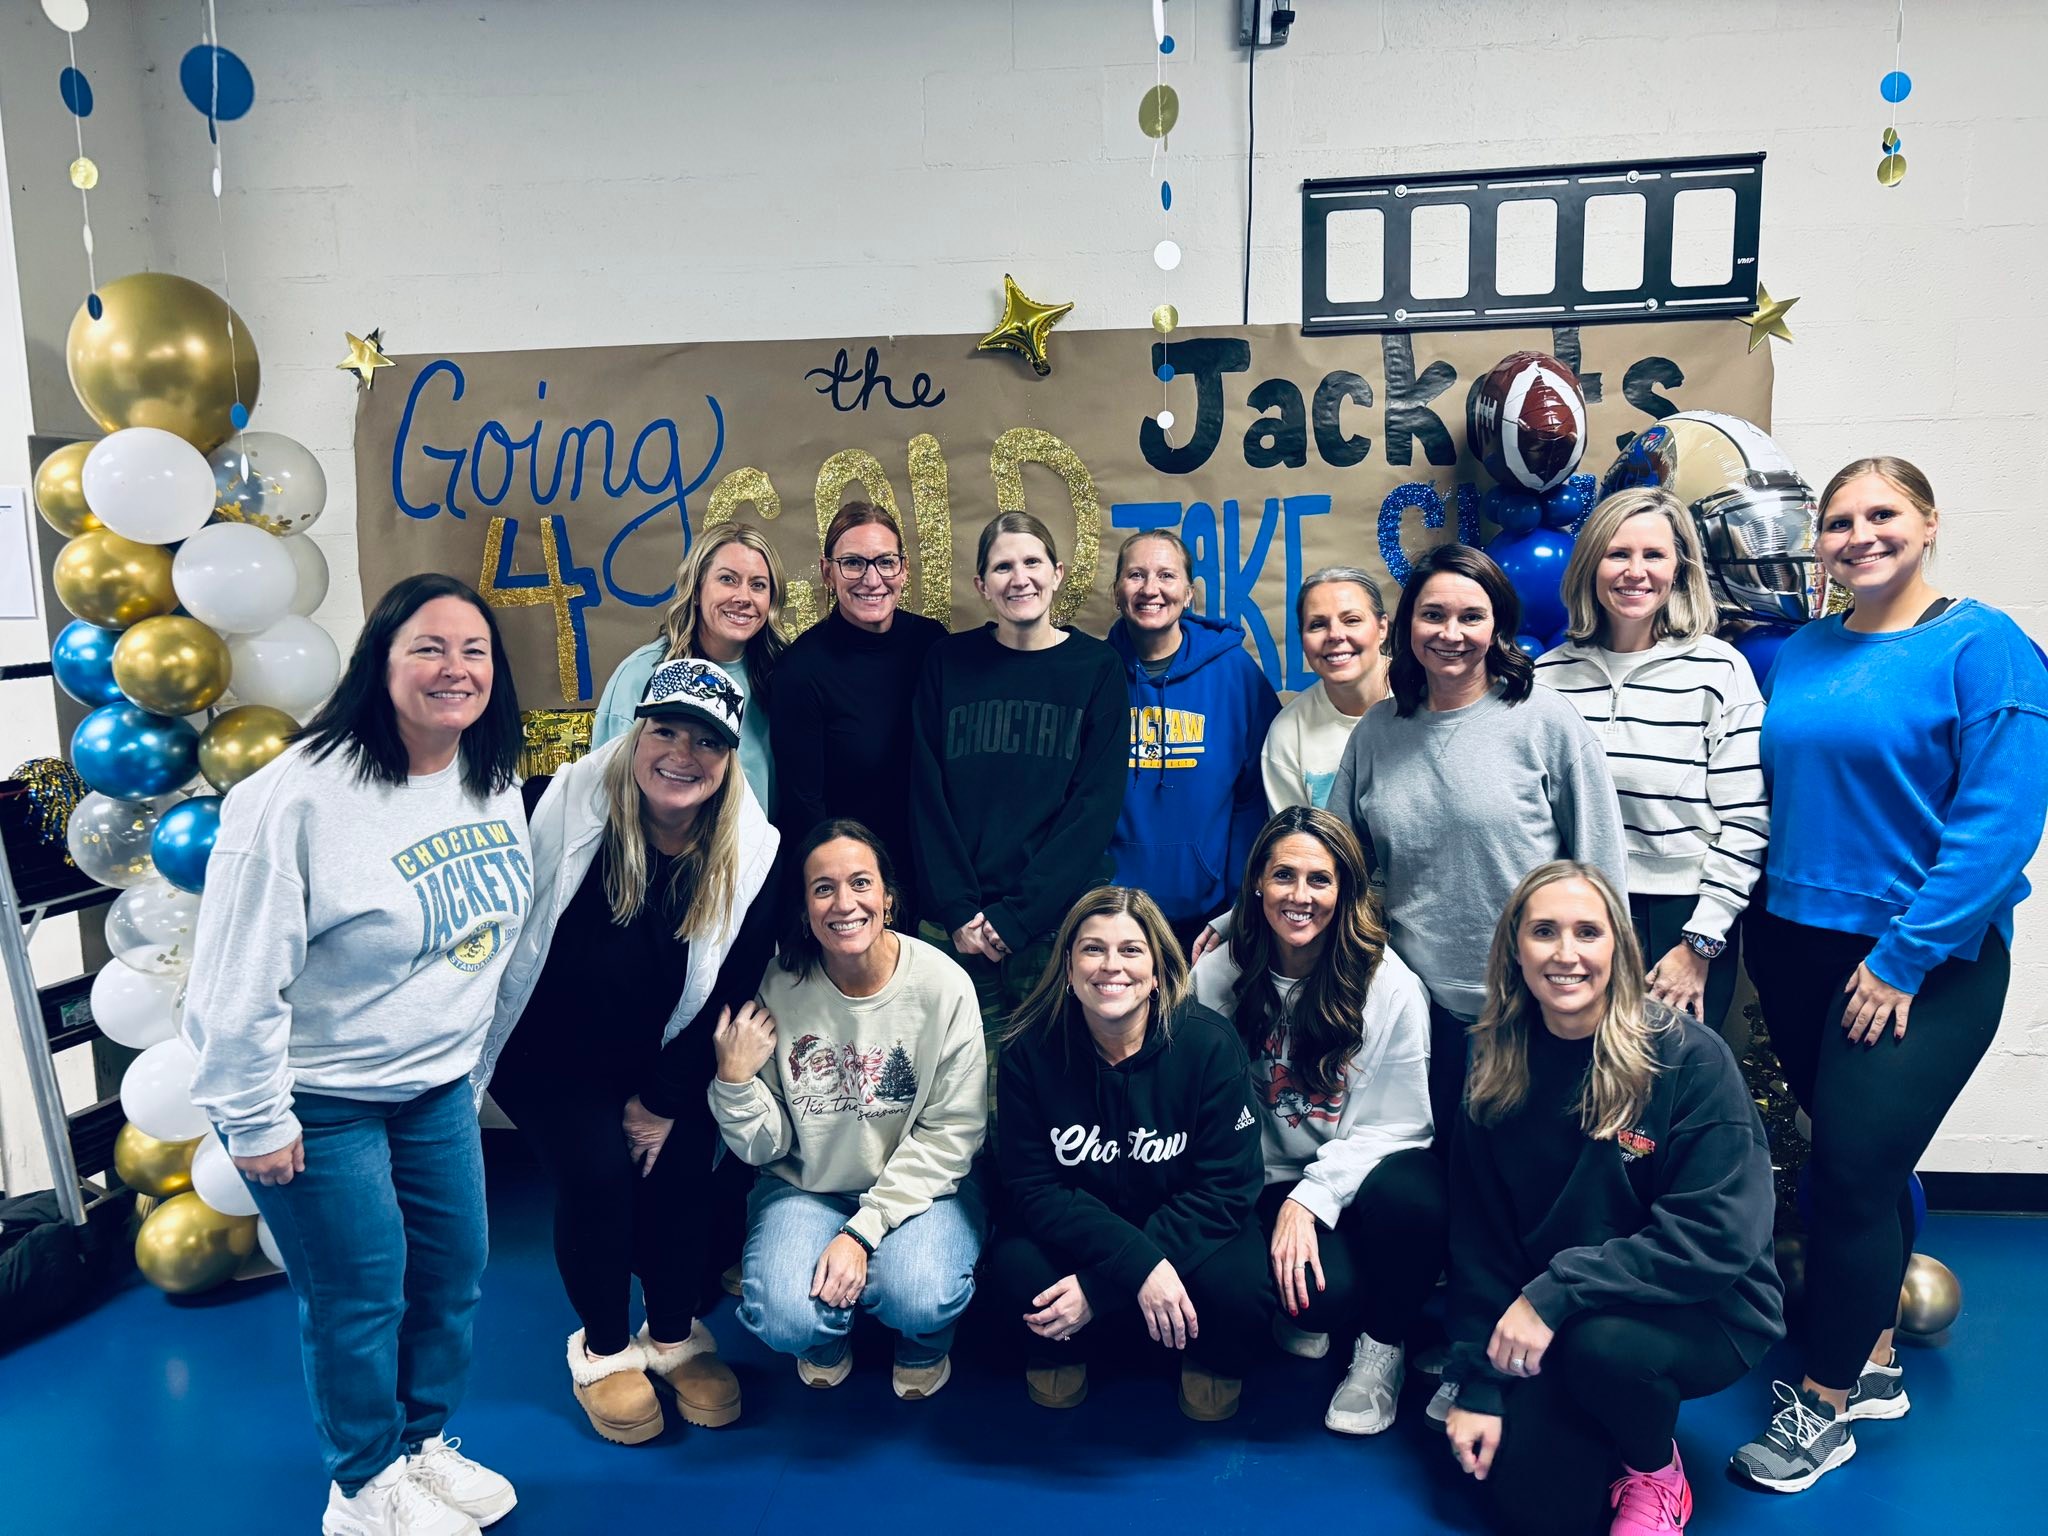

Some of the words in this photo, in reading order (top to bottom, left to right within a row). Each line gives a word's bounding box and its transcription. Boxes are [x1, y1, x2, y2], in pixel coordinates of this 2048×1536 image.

[805, 346, 946, 411] the
[1139, 325, 1684, 474] Jacks
[392, 359, 724, 607] Going
[478, 514, 602, 702] 4
[945, 699, 1084, 761] CHOCTAW
[398, 823, 509, 876] CHOCTAW
[411, 848, 533, 972] JACKETS
[449, 951, 497, 973] STANDARD
[830, 1094, 861, 1112] the
[1235, 1117, 1256, 1131] adidas
